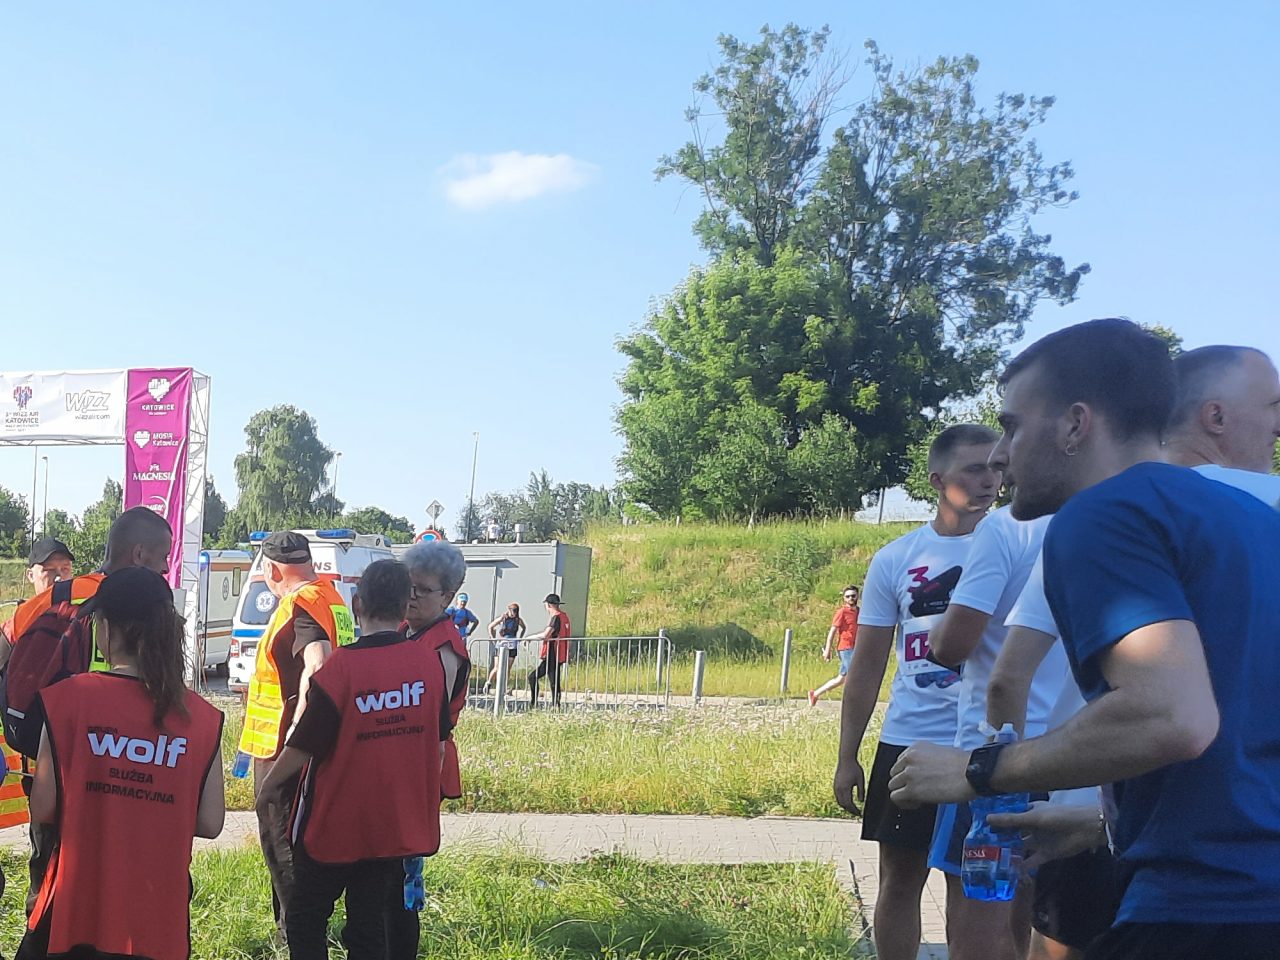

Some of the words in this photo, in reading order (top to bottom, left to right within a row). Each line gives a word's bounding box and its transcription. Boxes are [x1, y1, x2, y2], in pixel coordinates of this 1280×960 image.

[142, 403, 175, 411] KATOWICE
[354, 680, 426, 715] wolf
[86, 733, 187, 769] wolf
[86, 780, 175, 805] INFORMACYJNA
